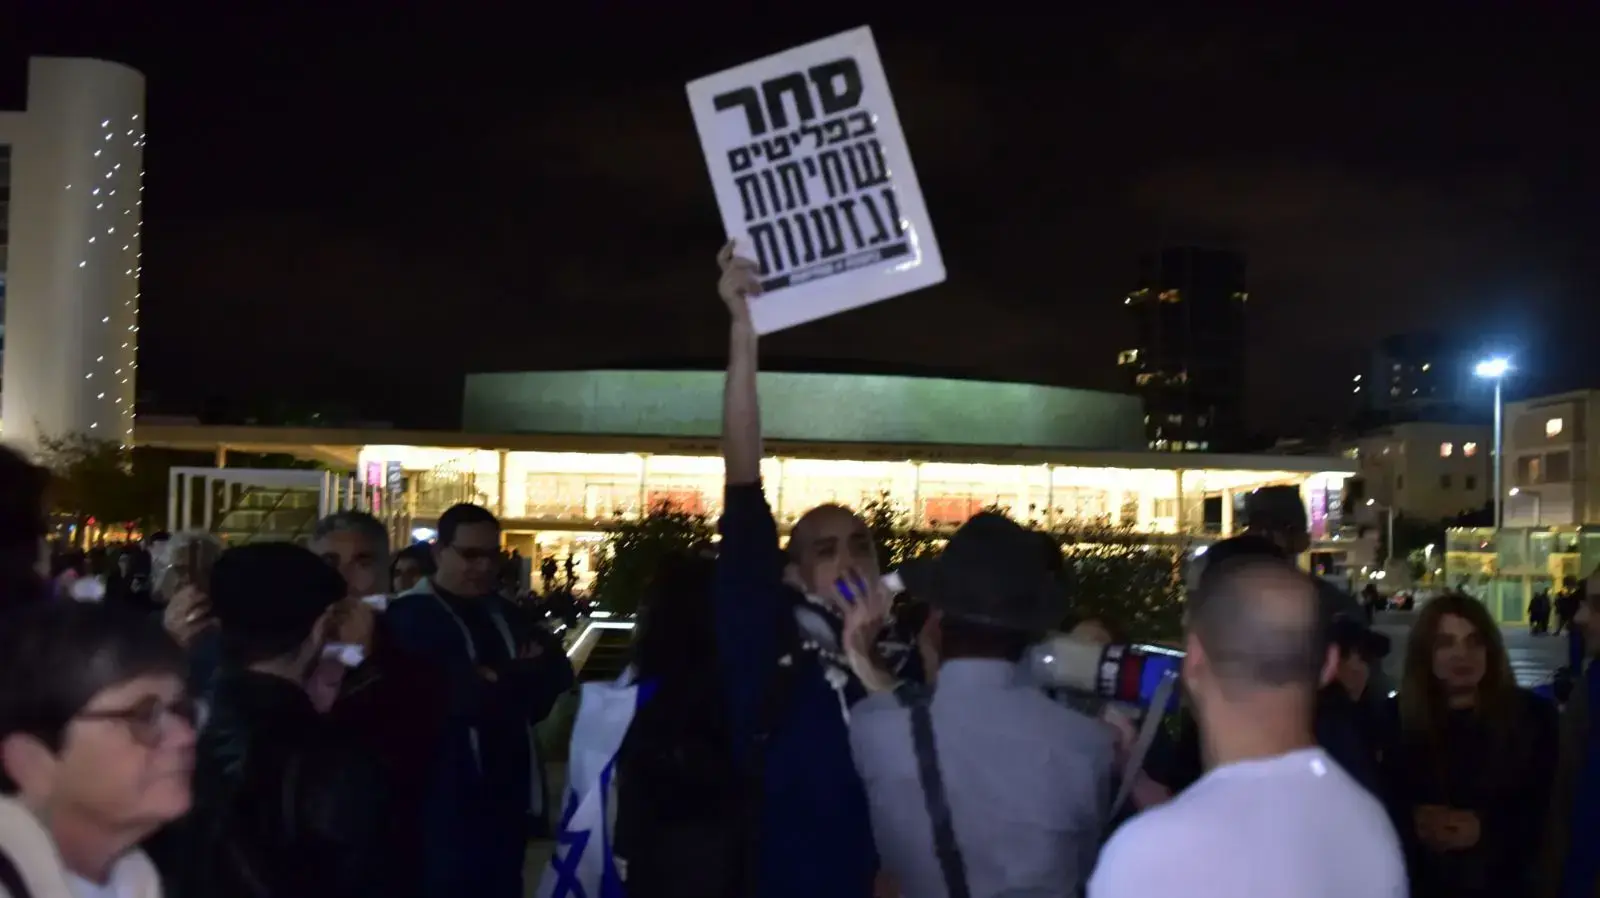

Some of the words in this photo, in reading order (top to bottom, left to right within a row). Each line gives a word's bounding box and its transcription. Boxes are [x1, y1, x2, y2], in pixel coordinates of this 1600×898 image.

[712, 57, 864, 137] סחר
[726, 110, 876, 173] בפליטים
[734, 137, 890, 223] שחיתות
[747, 187, 905, 277] וגזענות
